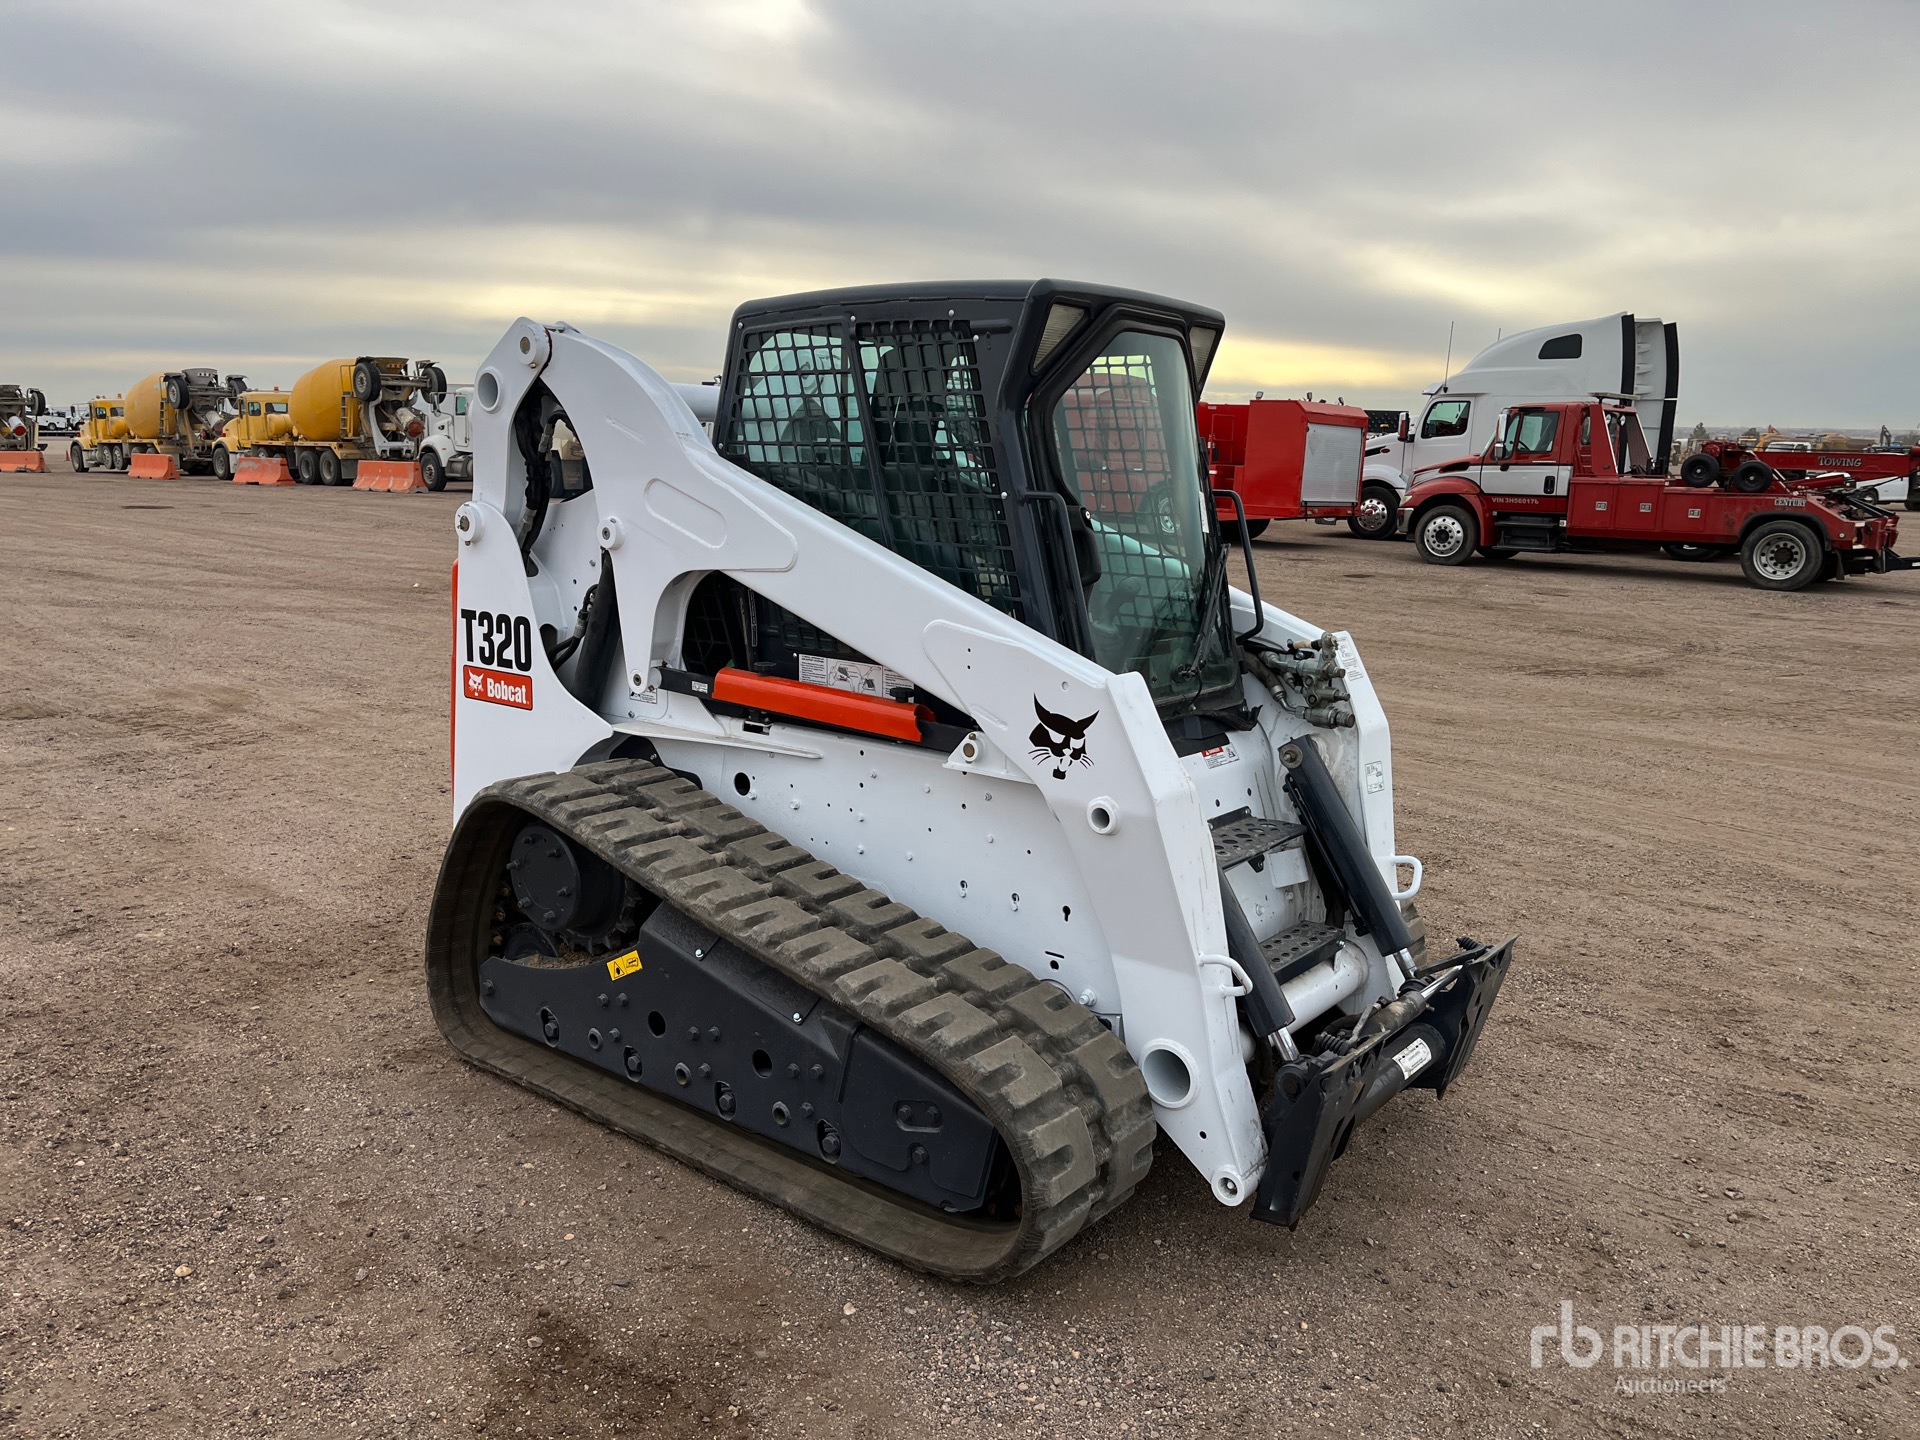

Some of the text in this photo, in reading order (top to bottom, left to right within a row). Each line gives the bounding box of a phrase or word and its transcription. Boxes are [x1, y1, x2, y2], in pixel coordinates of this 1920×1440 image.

[1774, 498, 1807, 507] CENTURY
[461, 608, 532, 672] T320
[487, 678, 527, 704] Bobcat
